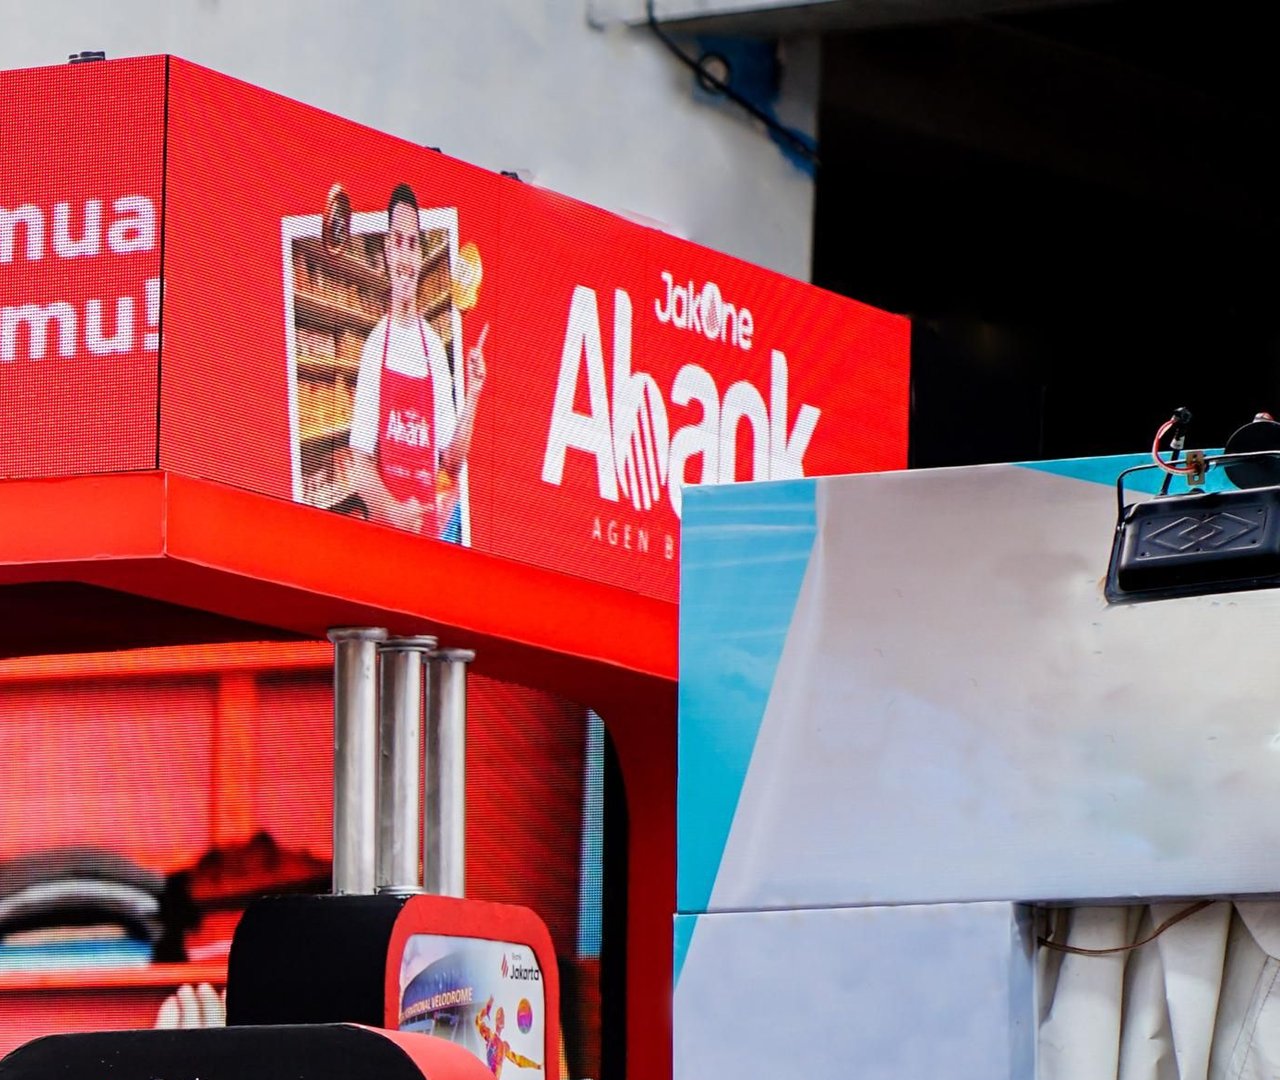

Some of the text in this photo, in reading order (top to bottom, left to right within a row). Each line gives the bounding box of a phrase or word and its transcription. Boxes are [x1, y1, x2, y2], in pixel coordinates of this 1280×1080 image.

[655, 270, 754, 350] JakOne
[592, 517, 649, 553] AGEN
[509, 965, 540, 981] Jakarta
